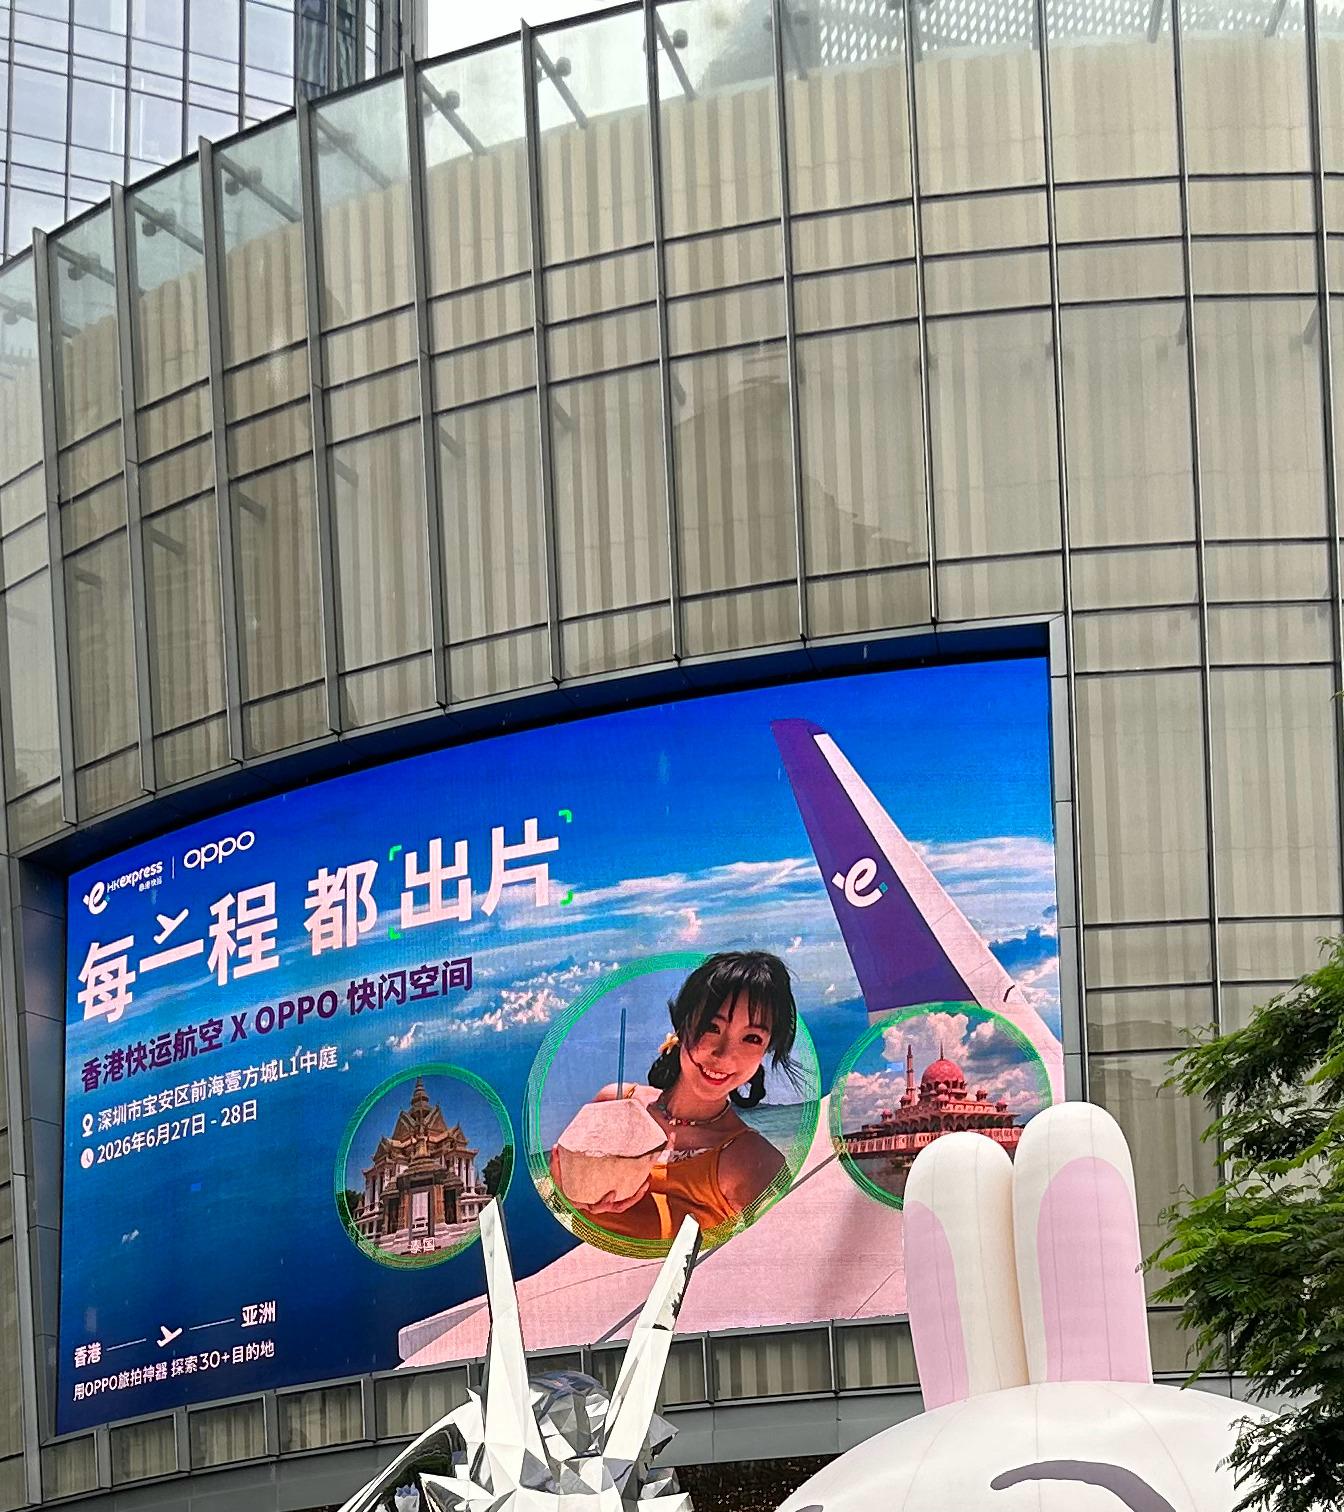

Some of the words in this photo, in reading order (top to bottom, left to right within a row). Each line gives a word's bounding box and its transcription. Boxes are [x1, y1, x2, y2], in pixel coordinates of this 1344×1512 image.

[183, 831, 256, 869] oppo
[77, 881, 280, 1023] 每一程
[304, 859, 380, 956] 都
[400, 817, 560, 931] 出片
[81, 1018, 224, 1093] 香港快运航空
[230, 1012, 248, 1043] X
[255, 991, 338, 1035] OPPO
[346, 957, 473, 1016] 快闪空间
[97, 1045, 338, 1132] 深圳市宝安区前海壹方城L1中庭
[96, 1113, 206, 1164] 2026年6月27日
[221, 1099, 258, 1127] 28日
[73, 1342, 102, 1368] 香港
[240, 1301, 277, 1329] 亚洲
[170, 1339, 275, 1377] 探索30+目的地
